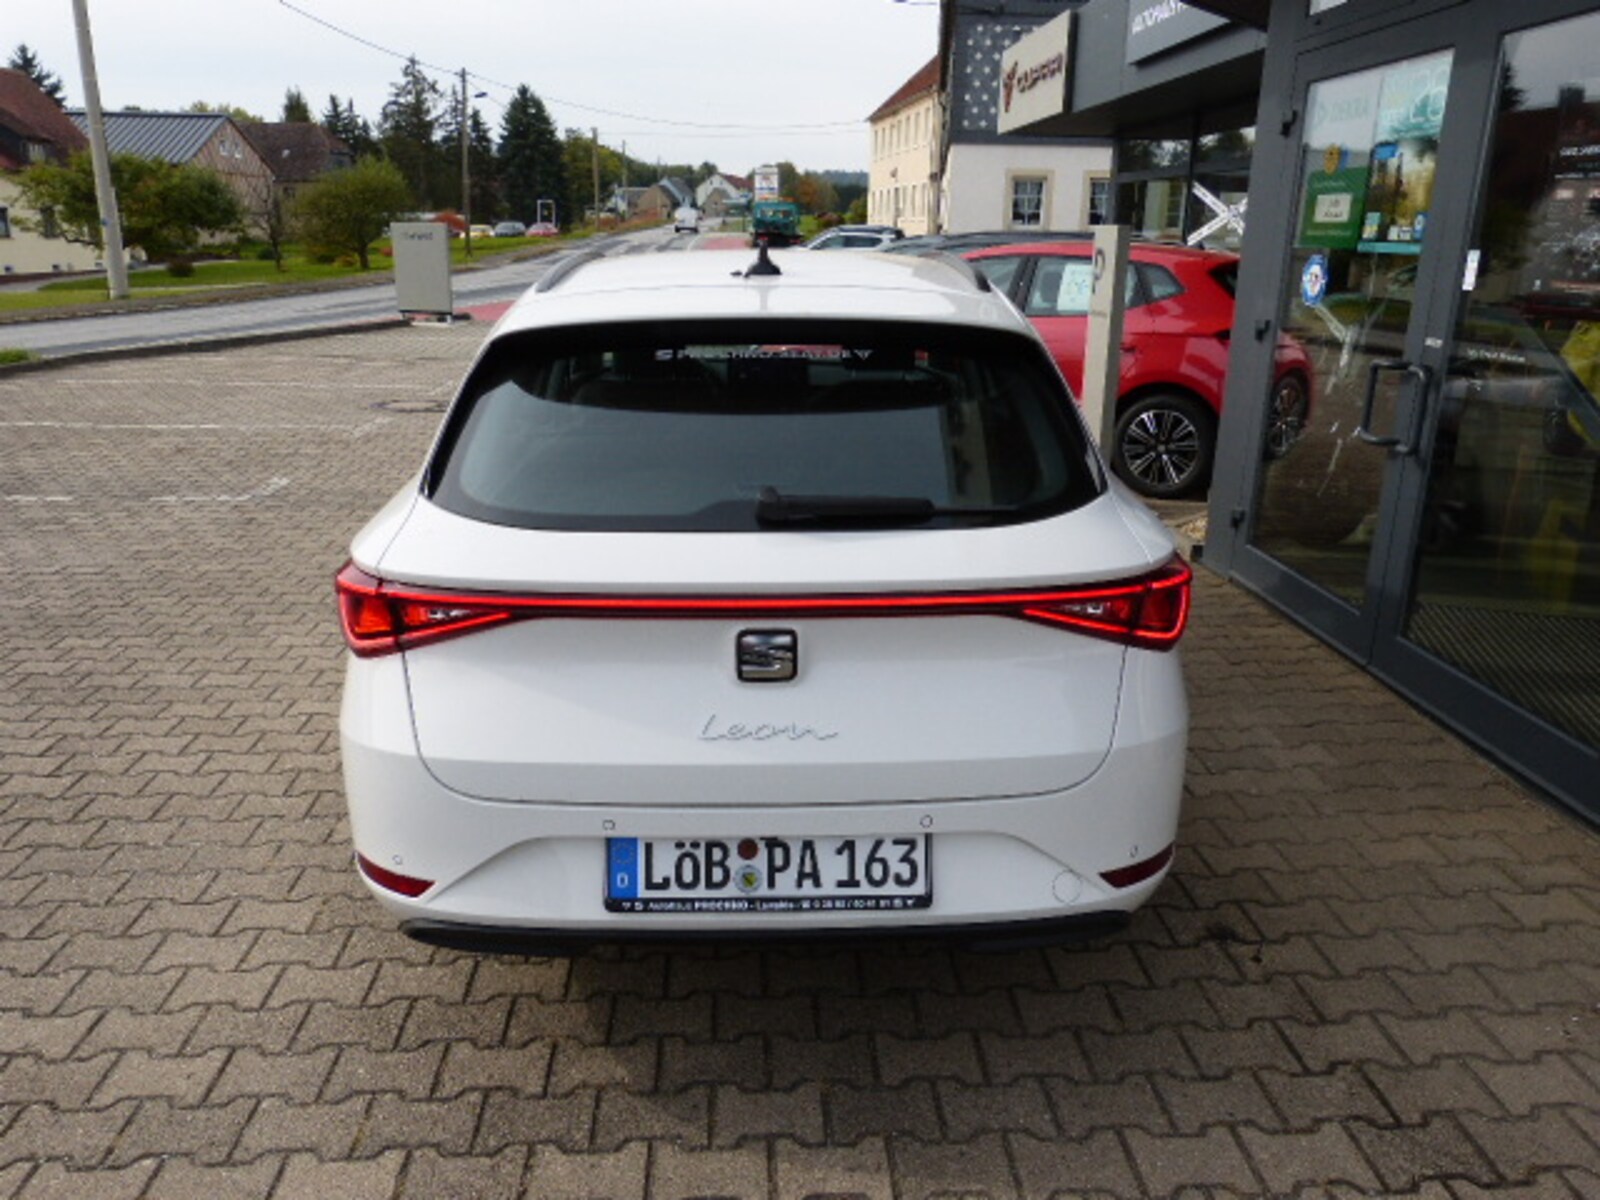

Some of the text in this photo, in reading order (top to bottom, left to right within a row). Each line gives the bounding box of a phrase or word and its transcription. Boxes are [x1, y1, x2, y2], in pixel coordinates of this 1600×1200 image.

[698, 713, 839, 741] Leon
[644, 838, 919, 890] LÖB PA 163
